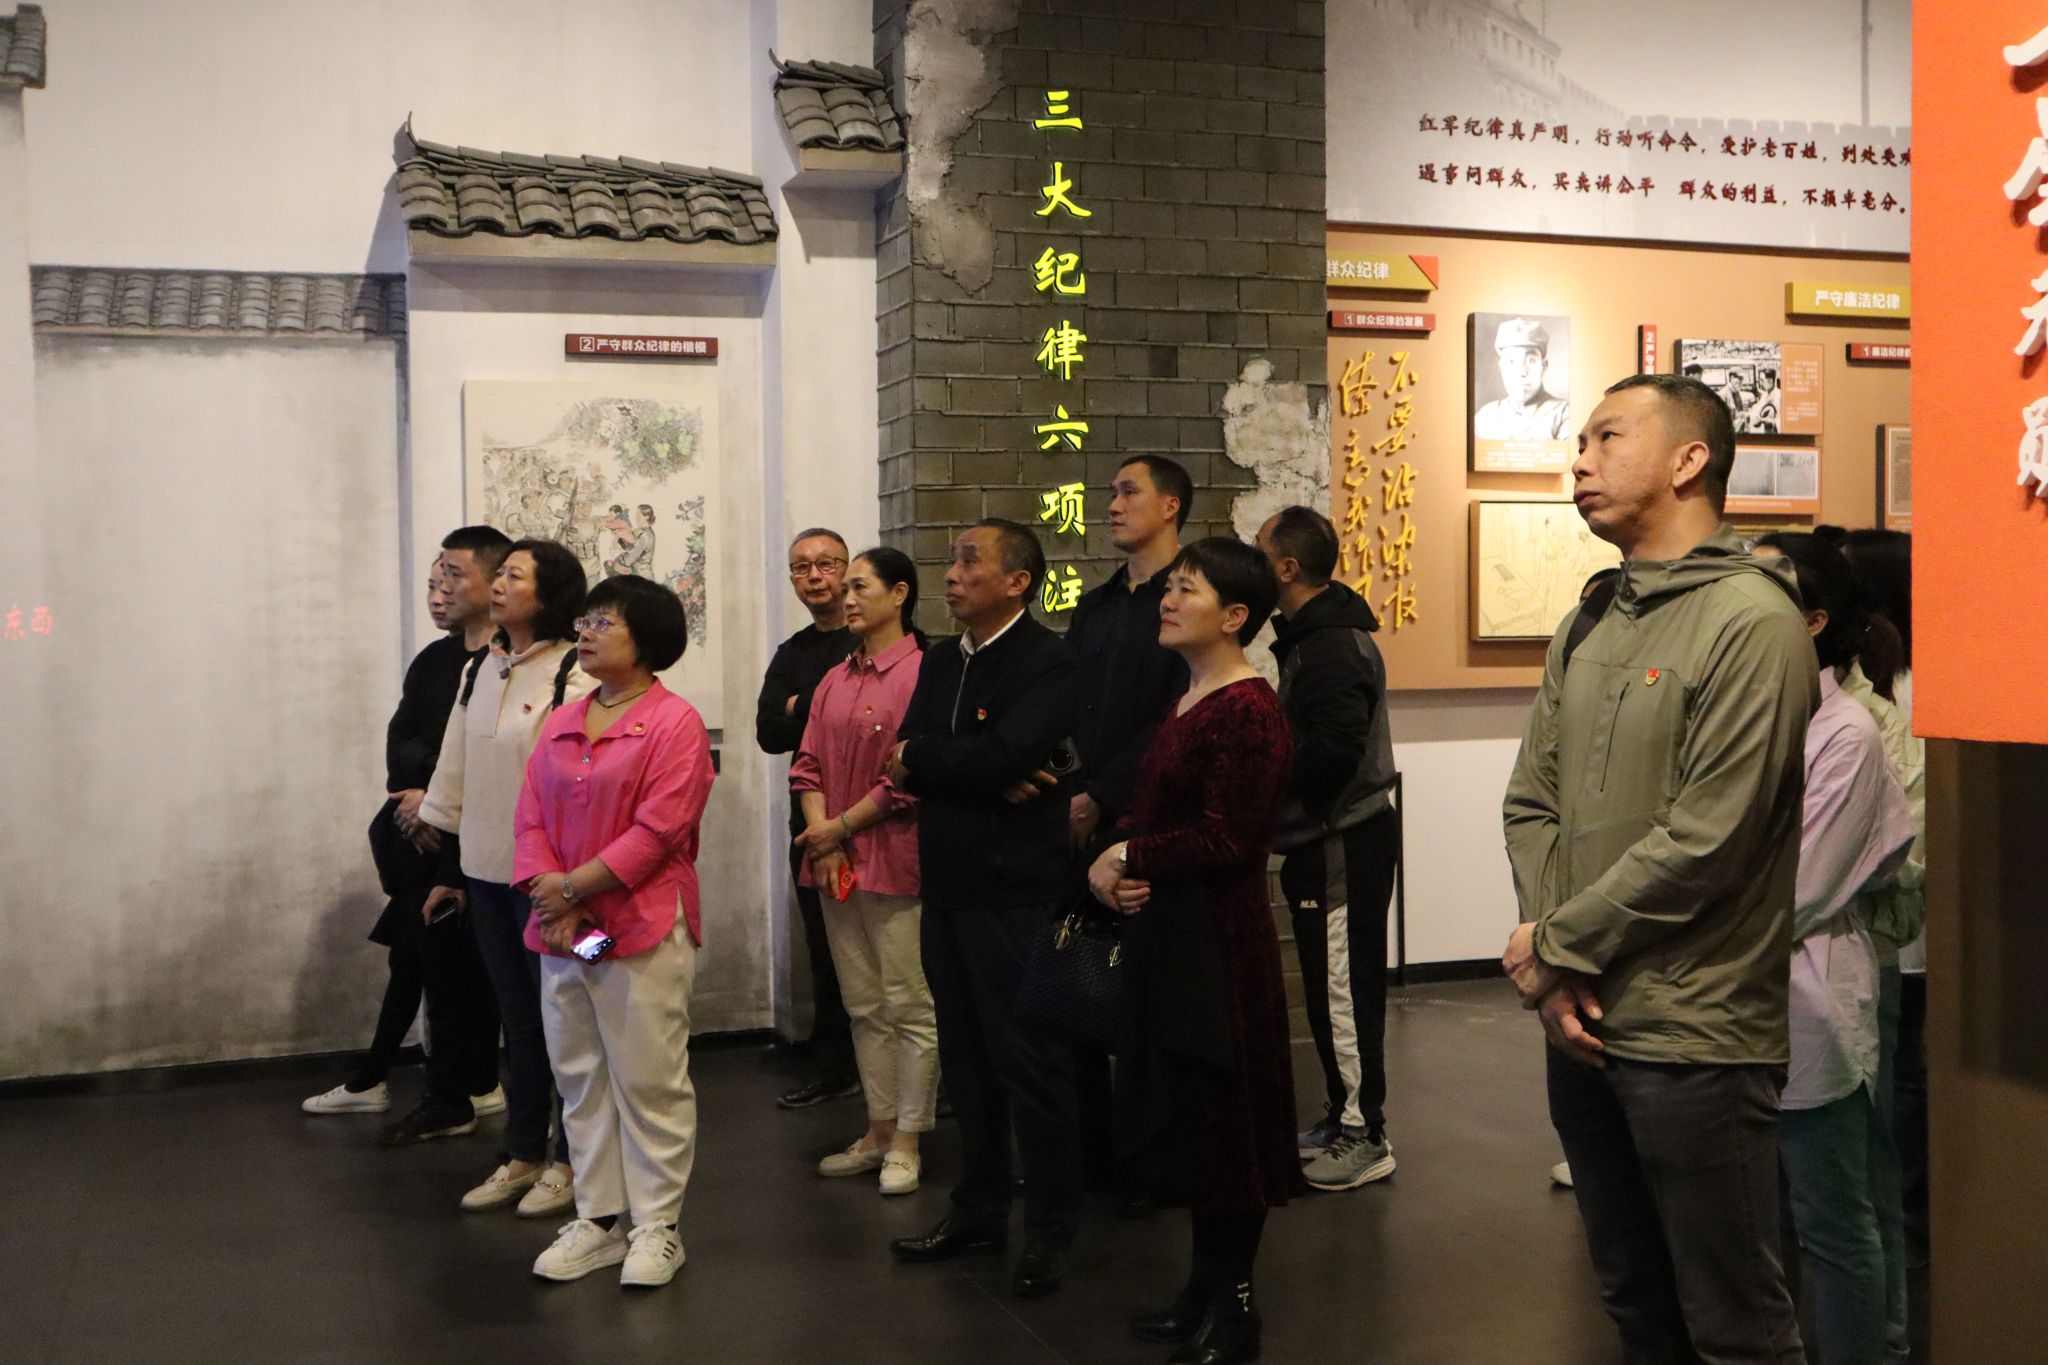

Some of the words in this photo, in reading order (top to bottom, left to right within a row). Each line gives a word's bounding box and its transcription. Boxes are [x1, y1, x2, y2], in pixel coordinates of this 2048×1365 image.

[1033, 90, 1092, 614] 三大纪律六项注
[1815, 289, 1900, 310] 严守廉洁纪律
